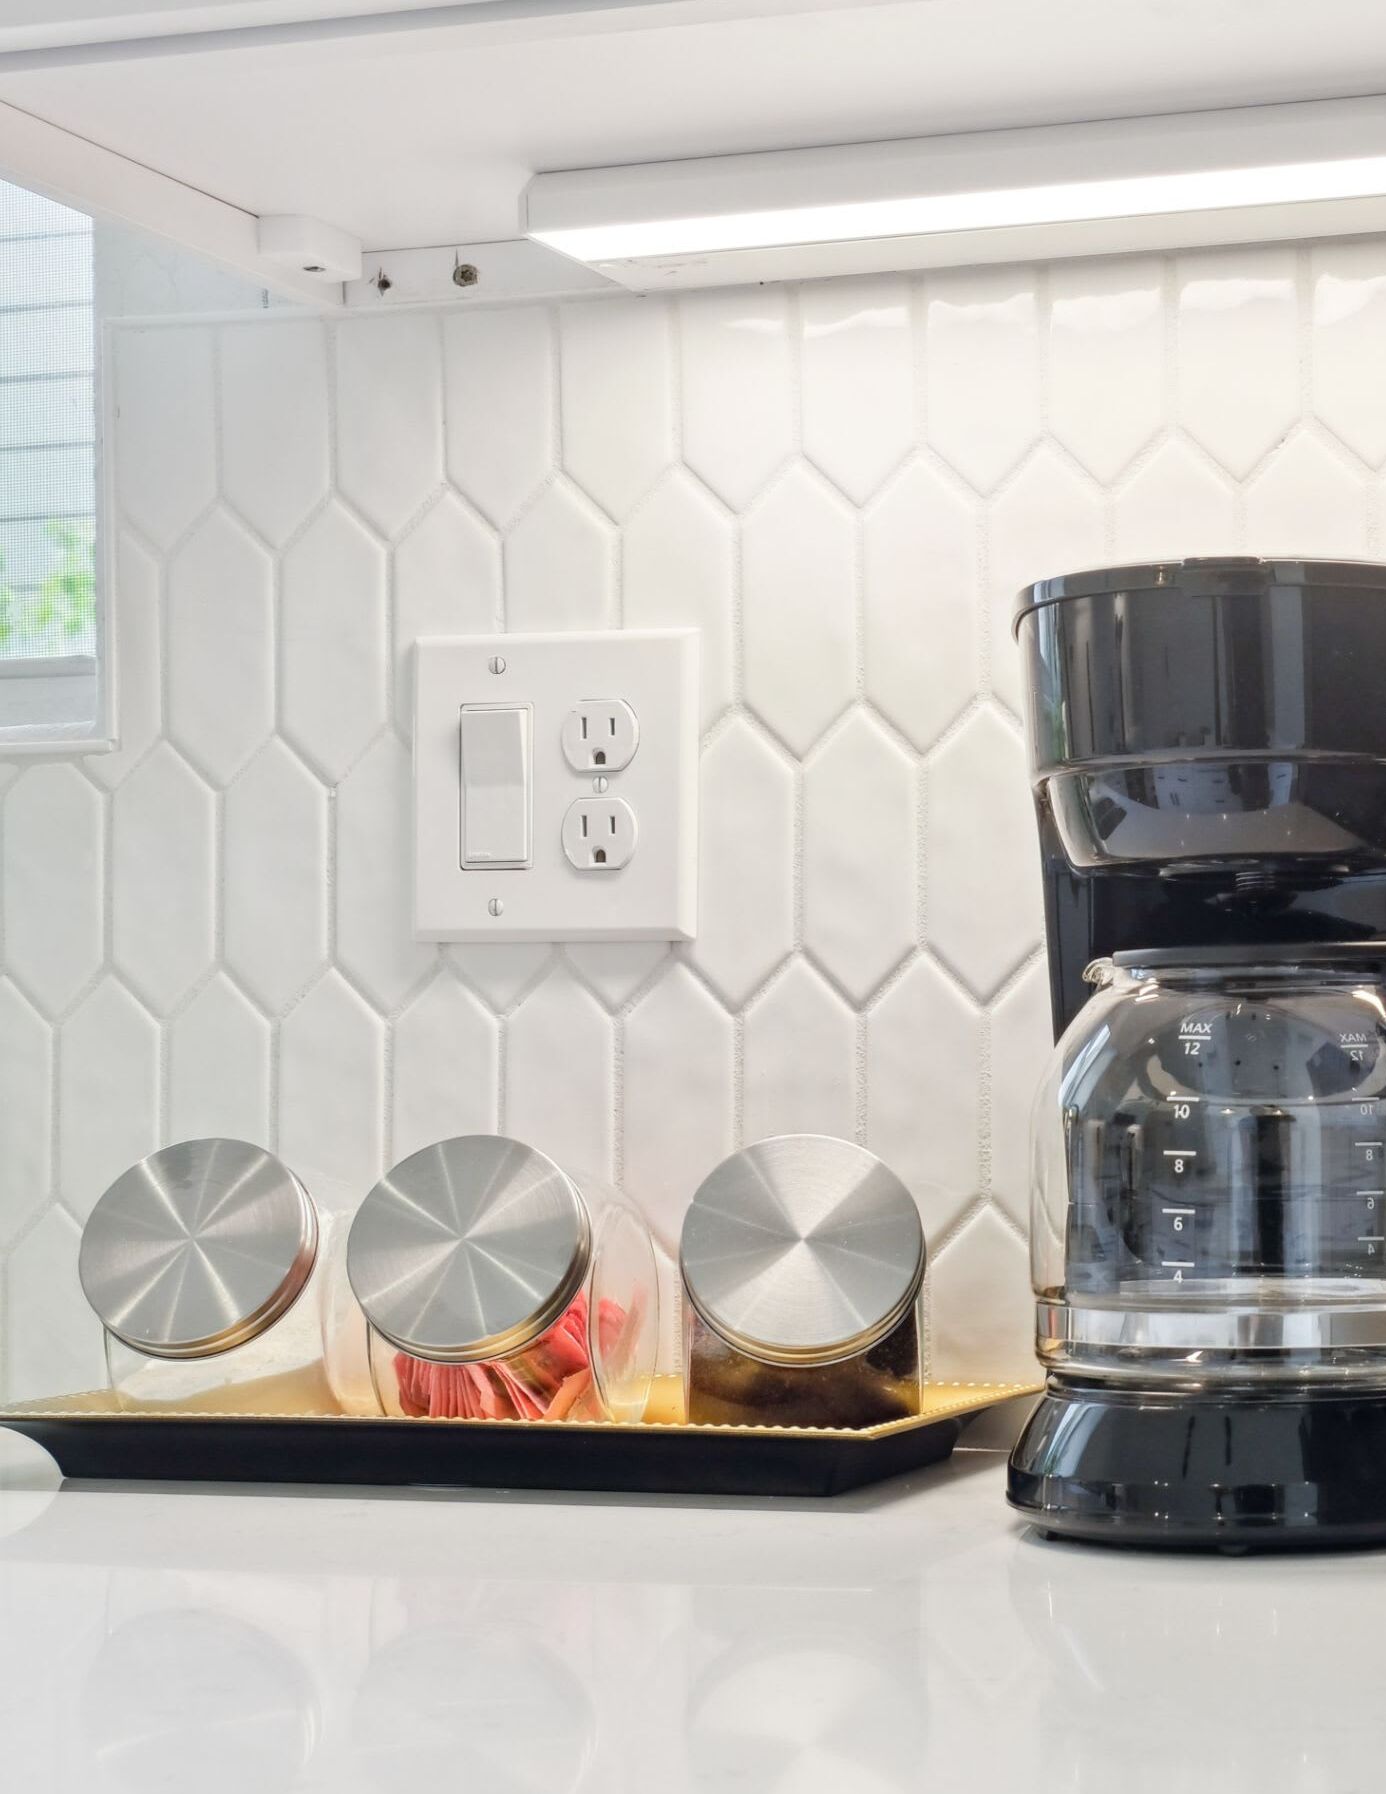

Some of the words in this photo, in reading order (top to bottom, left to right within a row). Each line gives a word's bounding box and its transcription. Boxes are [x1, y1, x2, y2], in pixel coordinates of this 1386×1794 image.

[1180, 1023, 1213, 1033] MAX
[1184, 1042, 1200, 1055] 12
[1173, 1104, 1190, 1119] 10
[1174, 1158, 1184, 1173] 8
[1173, 1217, 1183, 1231] 6
[1173, 1270, 1184, 1284] 4
